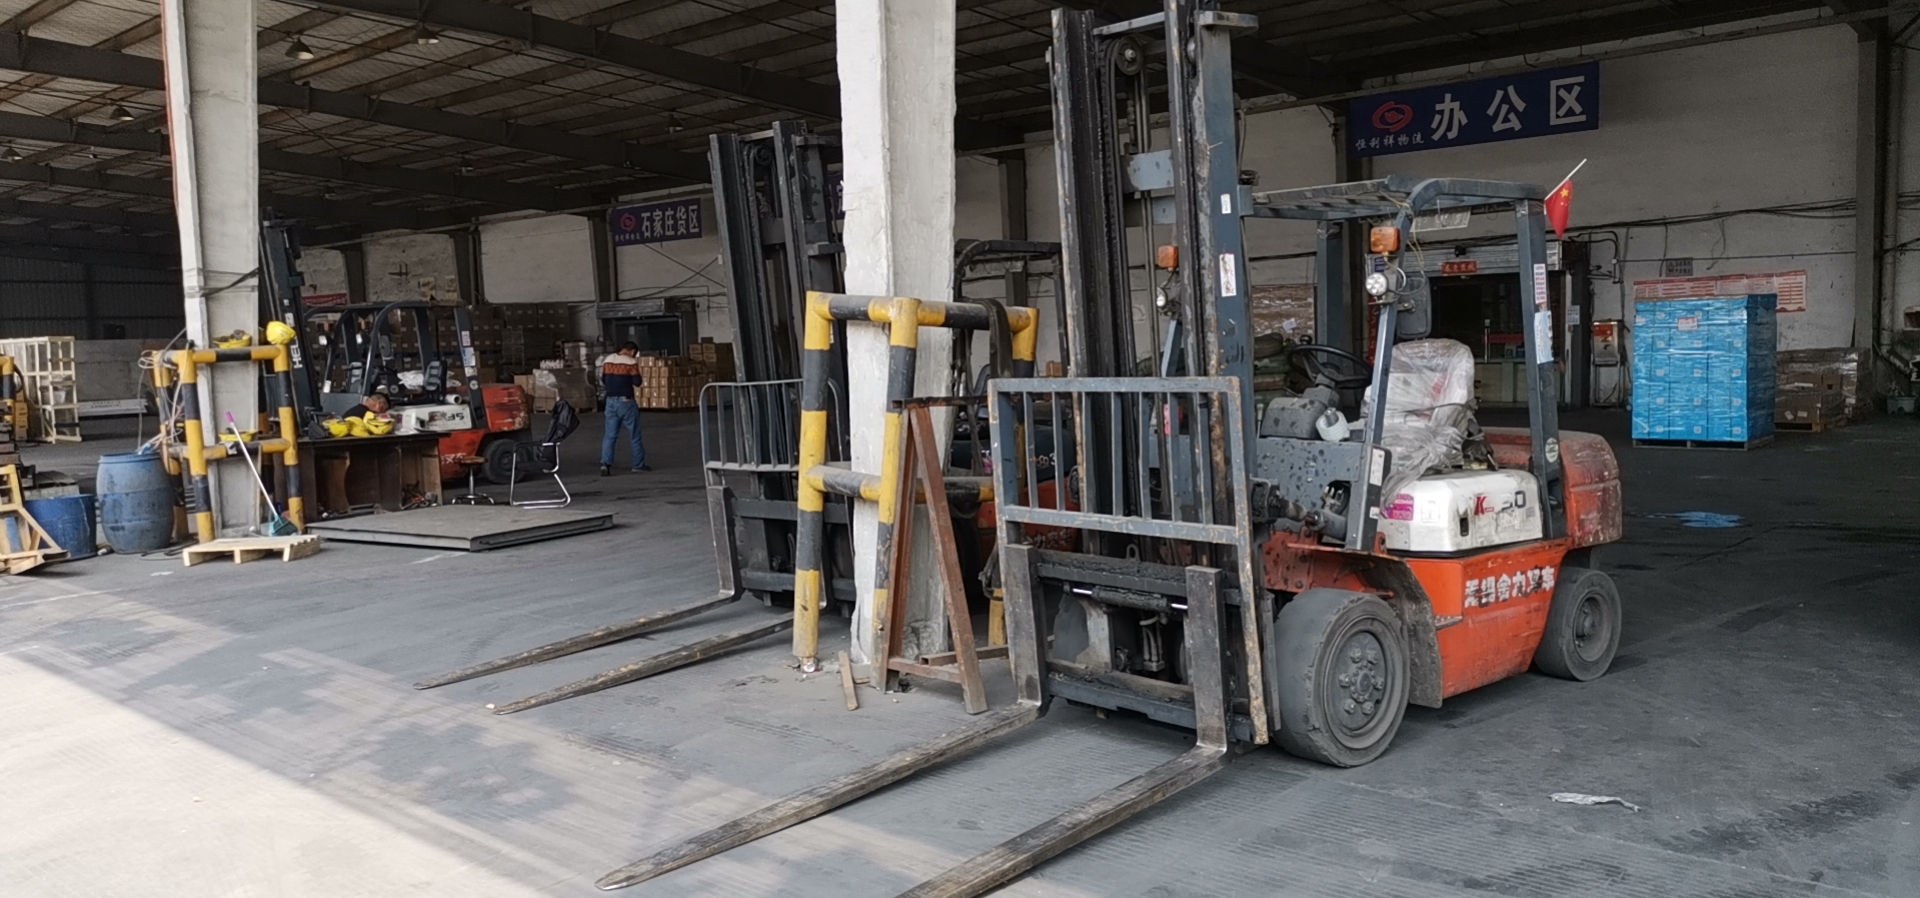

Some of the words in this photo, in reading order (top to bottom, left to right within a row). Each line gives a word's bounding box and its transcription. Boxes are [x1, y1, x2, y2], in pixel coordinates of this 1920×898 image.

[1430, 75, 1587, 141] 办公区
[641, 205, 700, 239] 石家庄货区
